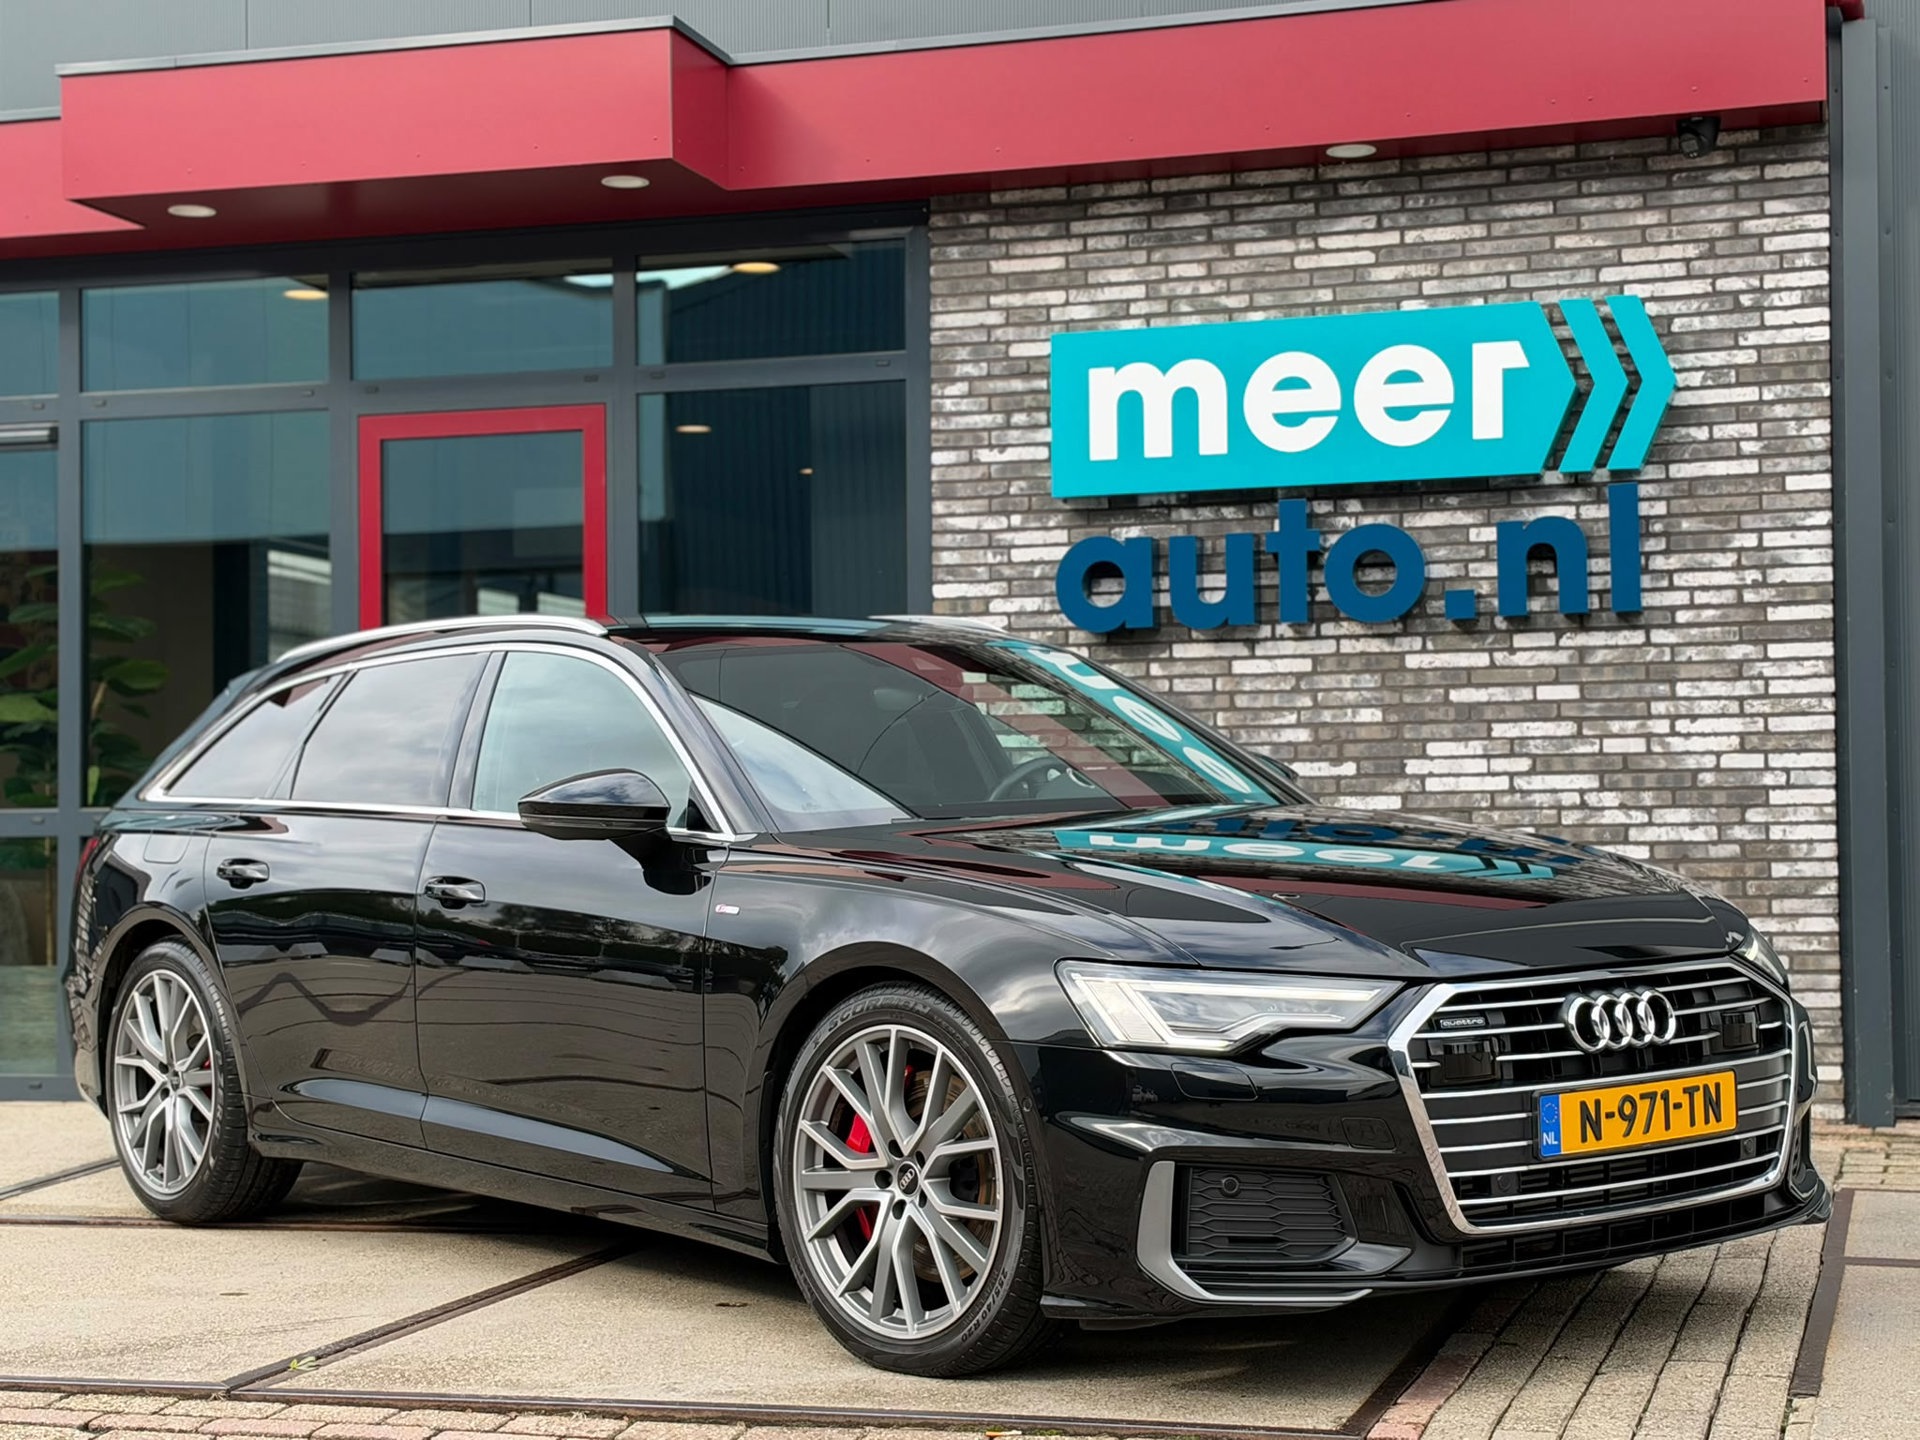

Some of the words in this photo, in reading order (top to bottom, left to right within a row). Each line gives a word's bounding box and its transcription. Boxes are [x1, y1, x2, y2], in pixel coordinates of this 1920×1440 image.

[1088, 340, 1530, 461] meer
[1055, 482, 1643, 634] auto.nl
[1440, 1017, 1485, 1029] quattro
[1542, 1131, 1559, 1146] NL
[1579, 1082, 1722, 1144] N-971-TN
